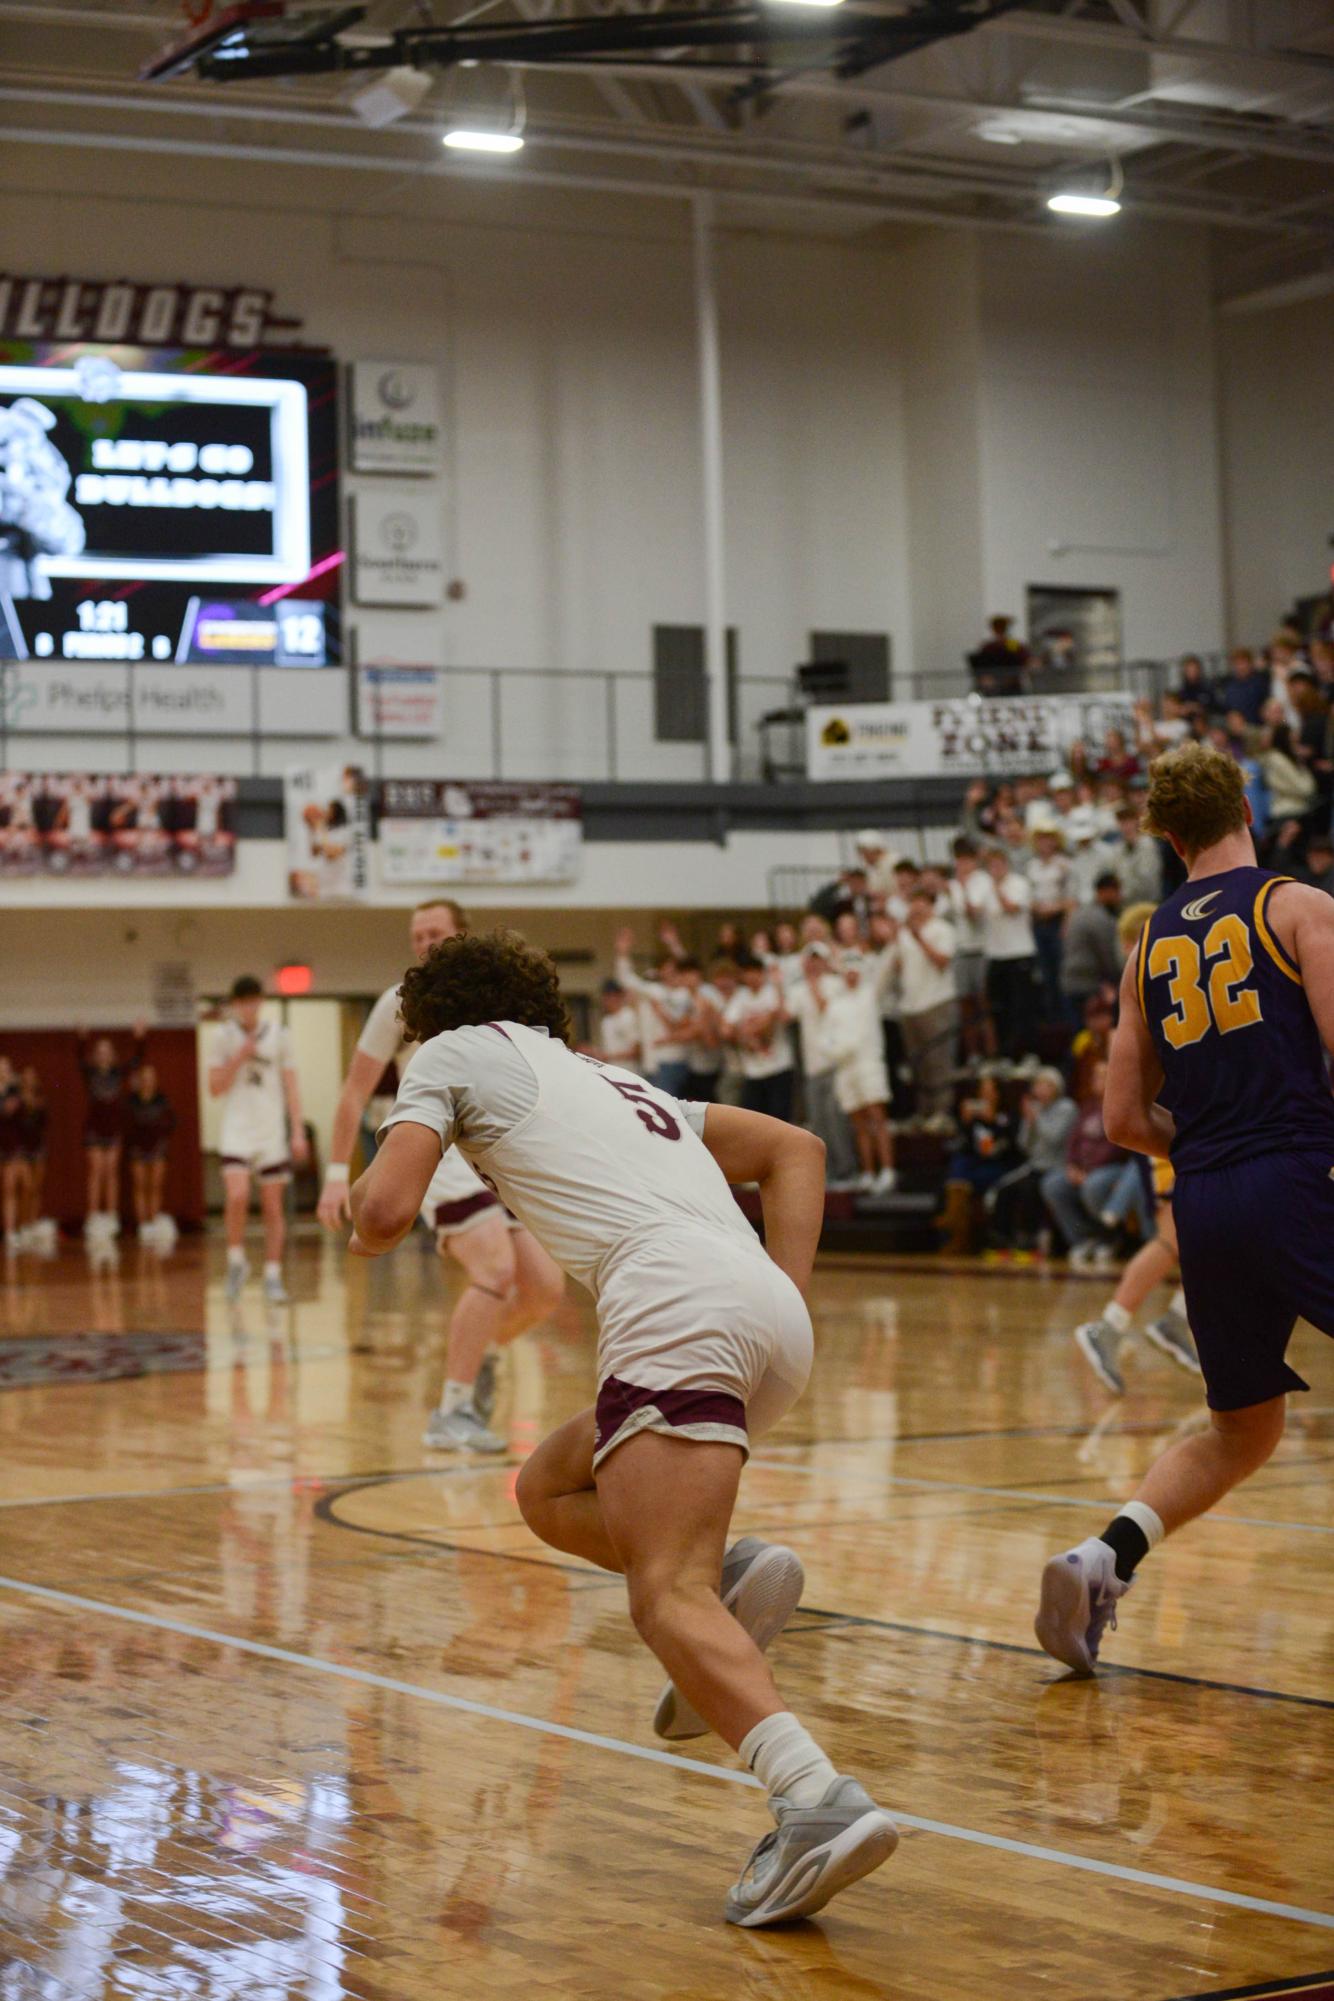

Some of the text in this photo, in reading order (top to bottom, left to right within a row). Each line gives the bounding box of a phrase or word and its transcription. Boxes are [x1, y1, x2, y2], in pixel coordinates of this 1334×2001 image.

[139, 684, 226, 711] Health
[1148, 913, 1264, 1050] 32
[596, 1073, 682, 1144] 5
